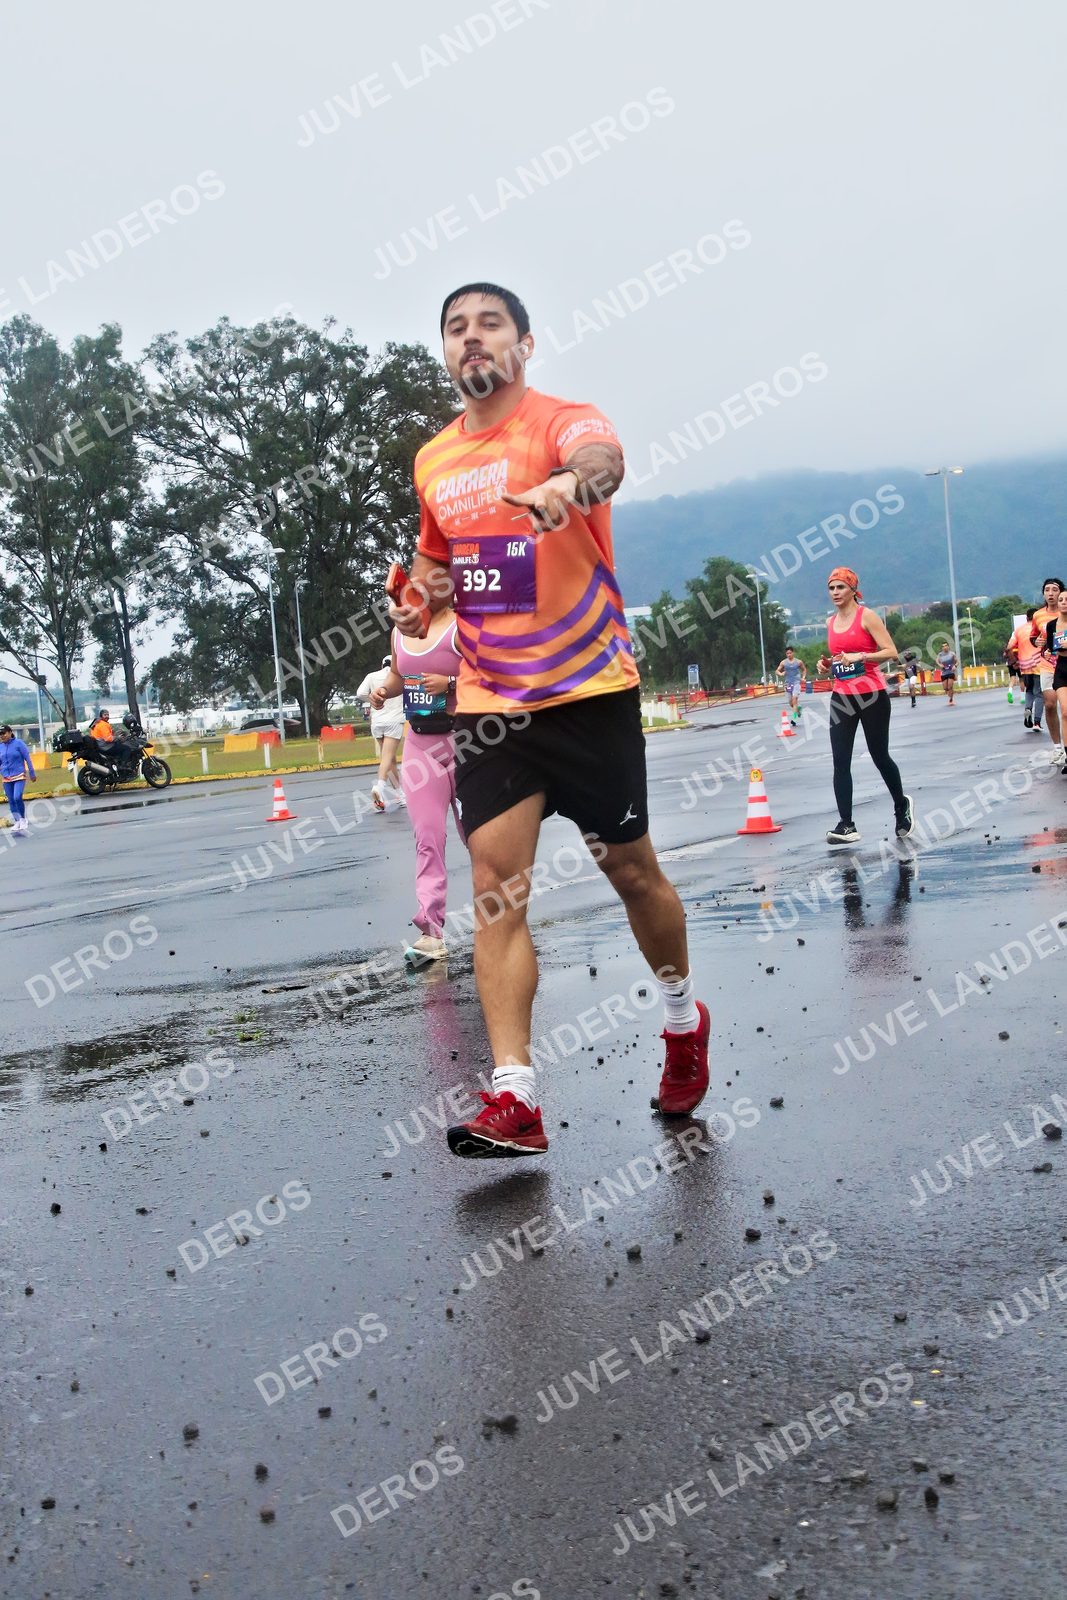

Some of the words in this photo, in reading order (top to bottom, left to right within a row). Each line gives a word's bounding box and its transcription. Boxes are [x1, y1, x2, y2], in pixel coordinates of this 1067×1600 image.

[436, 458, 509, 504] CARRERA
[506, 541, 527, 557] 15K
[462, 568, 502, 592] 392
[408, 691, 433, 705] 1530
